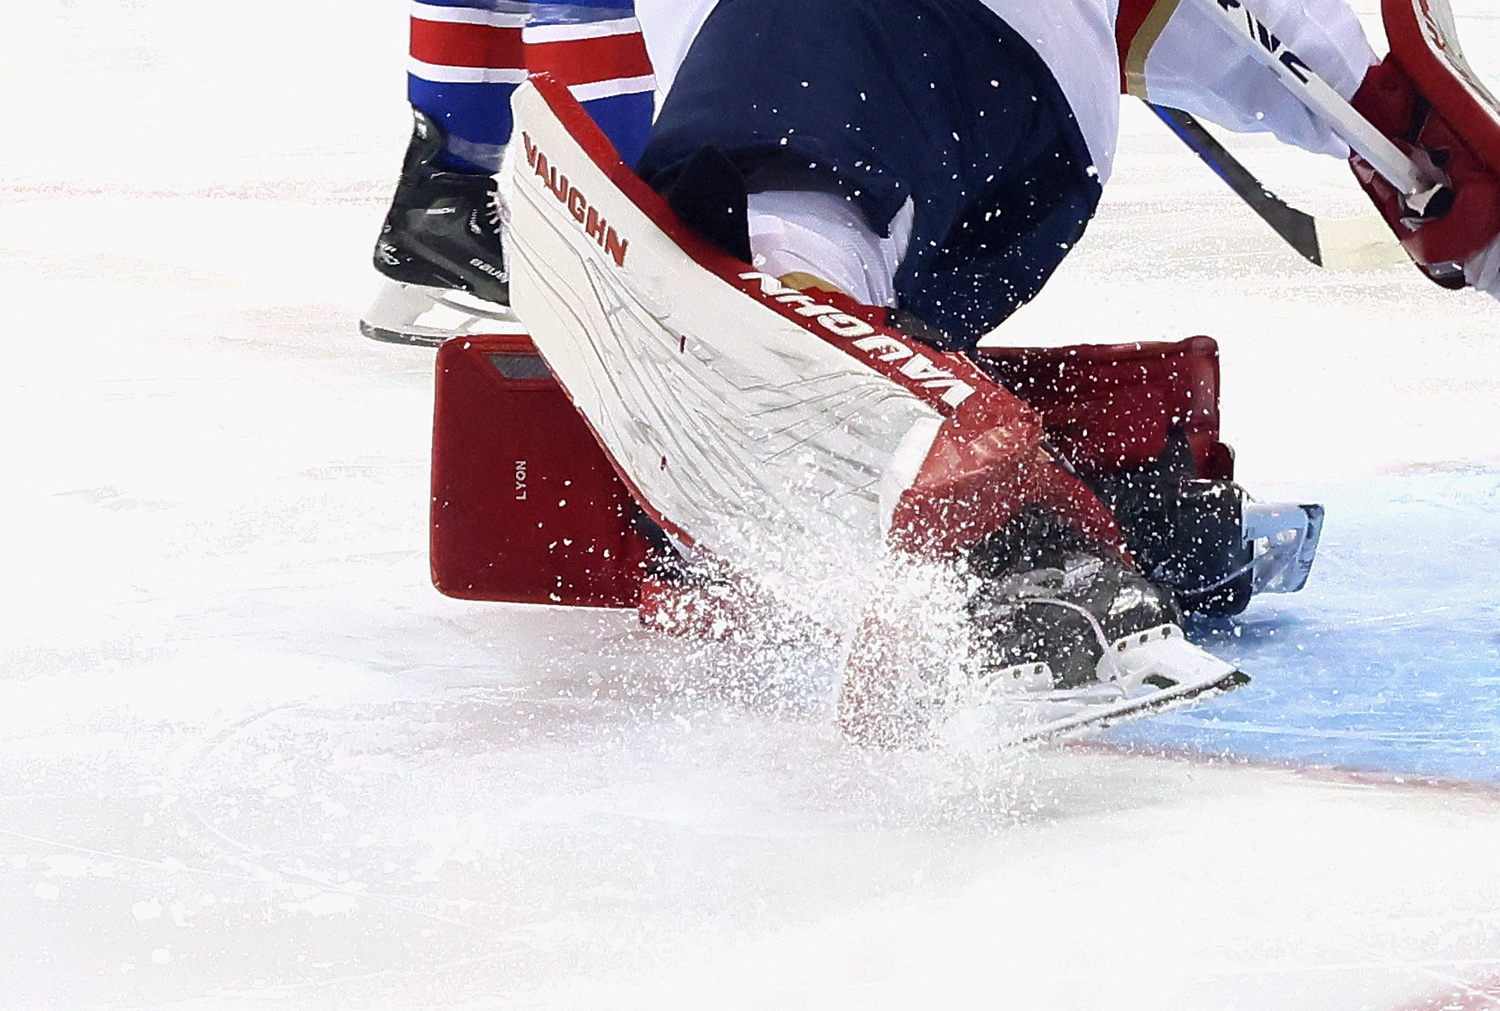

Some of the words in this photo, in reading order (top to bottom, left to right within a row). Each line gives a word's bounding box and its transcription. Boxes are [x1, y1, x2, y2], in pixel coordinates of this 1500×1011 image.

[521, 130, 629, 268] VAUGHN
[738, 271, 977, 410] VAUGHN
[515, 460, 527, 500] LYON
